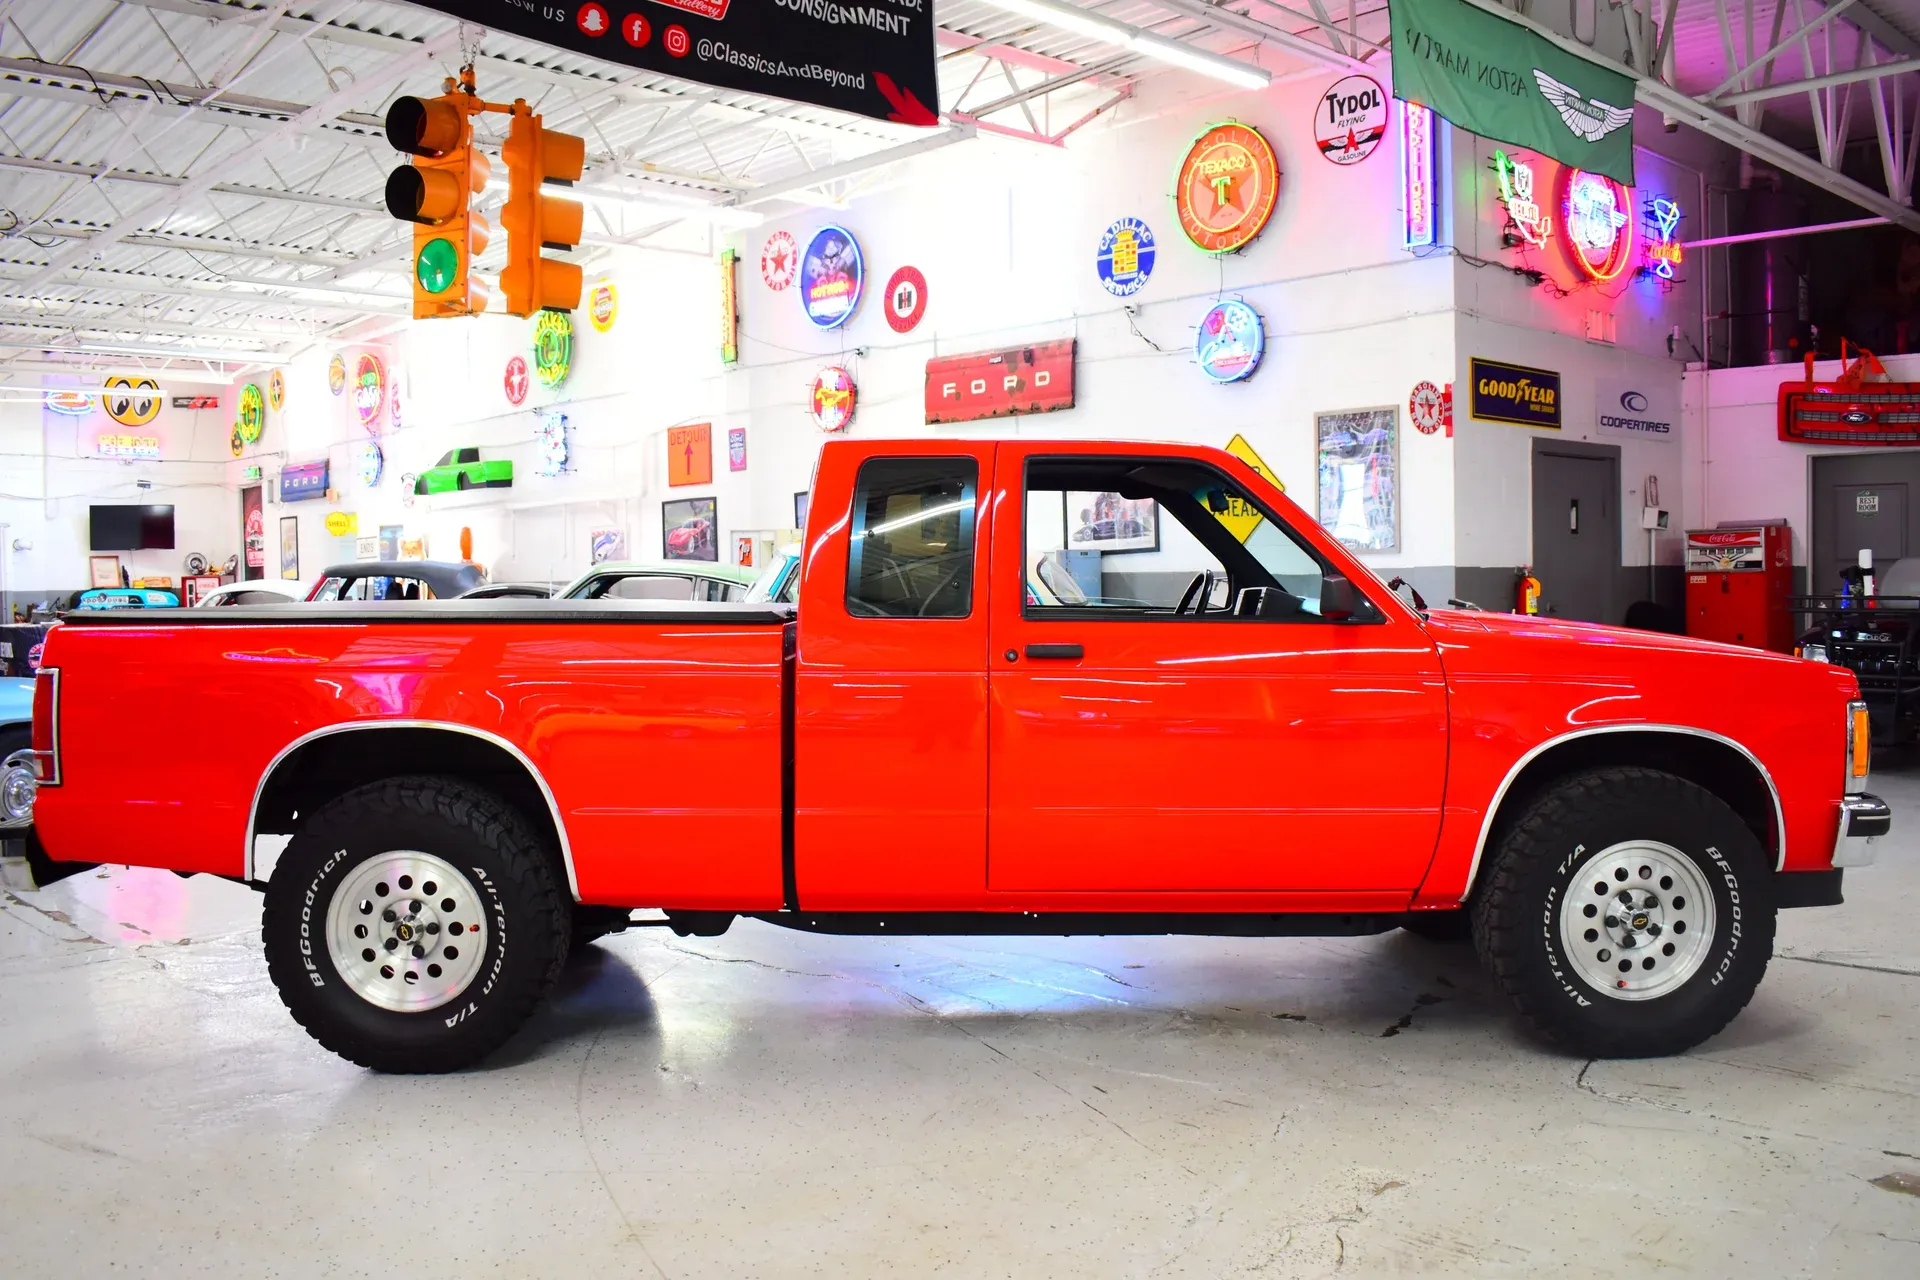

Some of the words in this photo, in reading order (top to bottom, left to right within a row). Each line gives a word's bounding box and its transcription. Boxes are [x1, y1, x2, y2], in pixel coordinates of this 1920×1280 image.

[543, 6, 565, 22] US
[697, 38, 865, 90] @ClassicsAndBeyond
[1326, 88, 1380, 123] TYDOL
[1337, 115, 1366, 129] FLYING
[1184, 129, 1270, 186] GASOLINE
[1197, 154, 1249, 175] TEXACO
[1337, 150, 1366, 162] GASOLINE
[1101, 219, 1151, 250] CADILLAC
[1182, 205, 1242, 249] MOTOR
[1103, 270, 1148, 295] SERVICE
[943, 371, 1051, 398] FORD
[1411, 381, 1442, 402] GASOLINE
[1479, 378, 1555, 405] GOODYEAR
[1411, 412, 1434, 433] MOTOR
[1435, 415, 1444, 429] OIL
[670, 428, 706, 446] DETOUR
[284, 475, 319, 489] FORD
[1212, 499, 1260, 517] EAD
[1858, 503, 1876, 511] ROOM
[1557, 843, 1586, 876] T/A
[300, 848, 348, 988] BFGoodrich
[1705, 846, 1743, 988] BFGoodrich
[471, 866, 508, 996] All-Terrain
[1540, 885, 1592, 1007] All-Terrain
[445, 1001, 479, 1029] T/A
